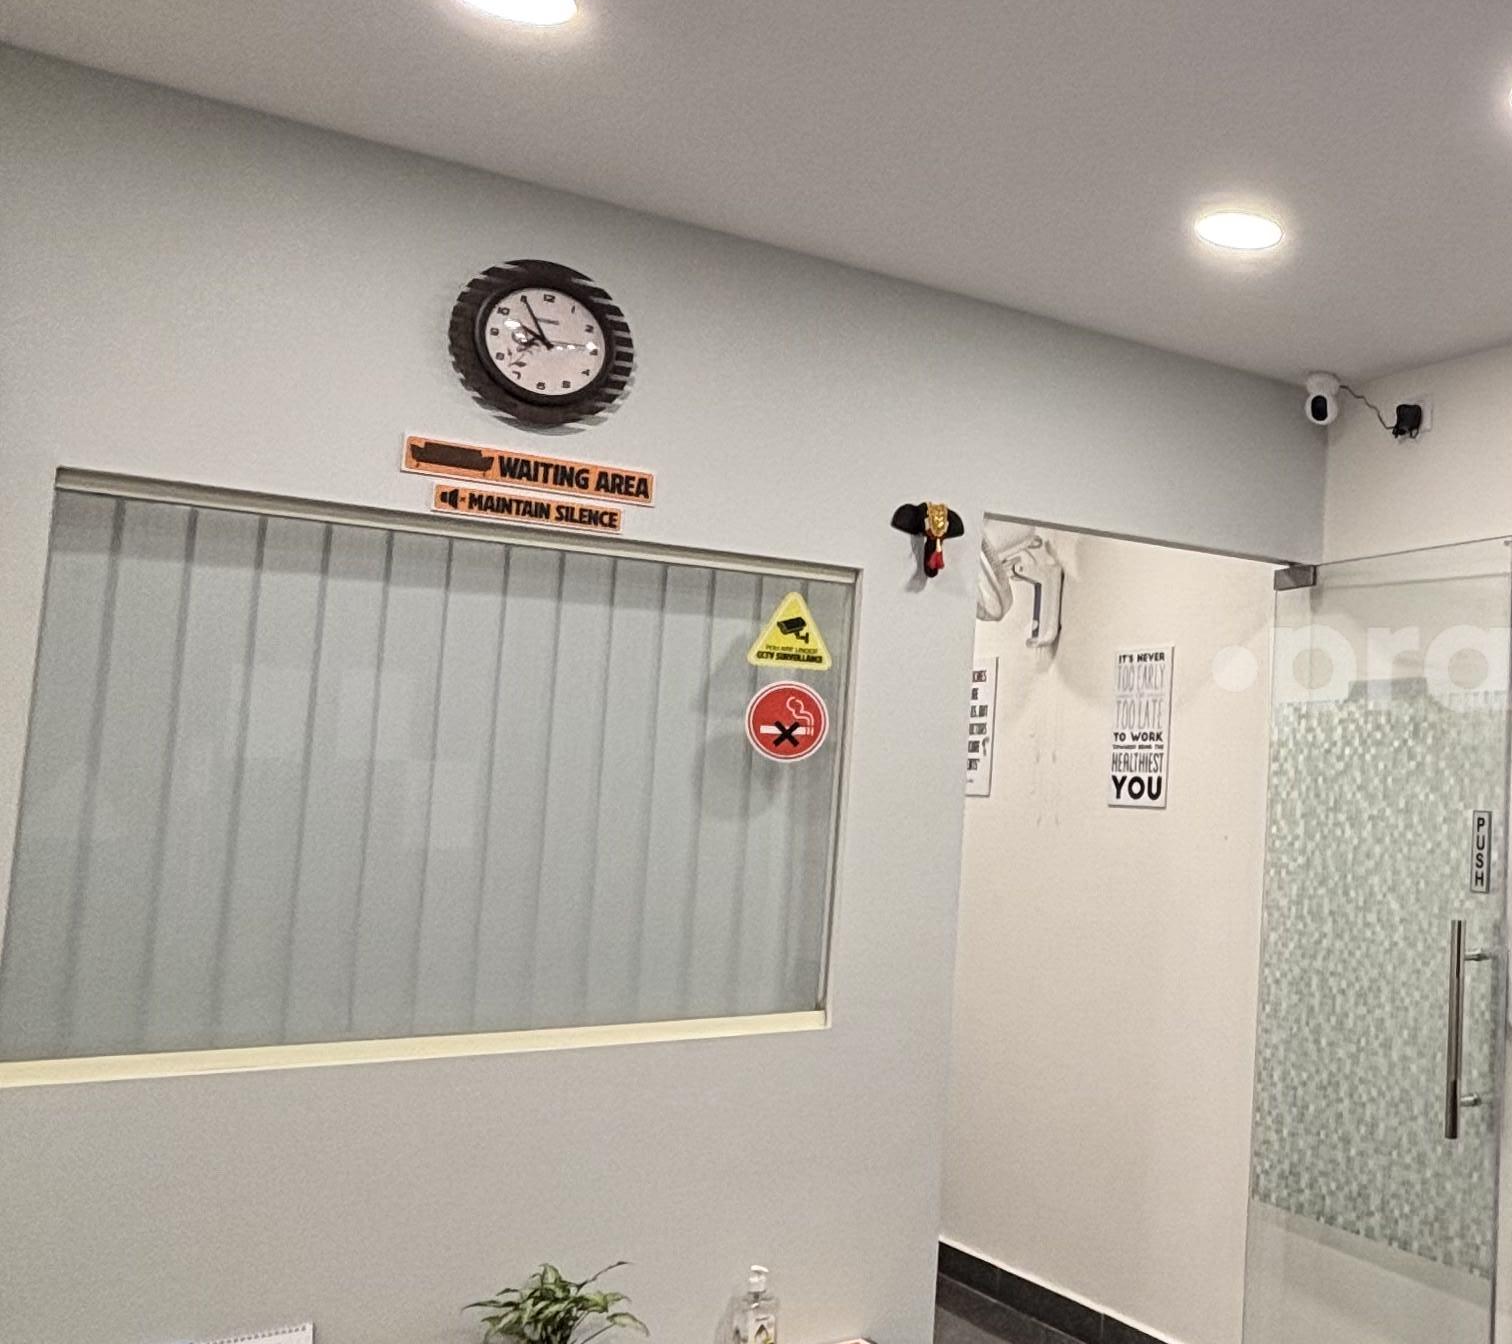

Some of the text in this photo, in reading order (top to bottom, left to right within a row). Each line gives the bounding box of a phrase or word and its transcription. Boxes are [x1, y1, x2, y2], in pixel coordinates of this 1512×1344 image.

[498, 455, 650, 499] WAITING AREA
[468, 493, 618, 529] MAINTAIN SILENCE
[757, 650, 775, 659] CCTV
[1119, 652, 1165, 664] IT'S NEVER
[1117, 663, 1165, 692] TOO EARLY
[1116, 698, 1163, 730] TOO LATE
[1113, 731, 1163, 742] TO WORK
[1112, 752, 1164, 774] HEALTHIEST
[1112, 775, 1162, 801] YOU
[1475, 817, 1485, 887] PUSH
